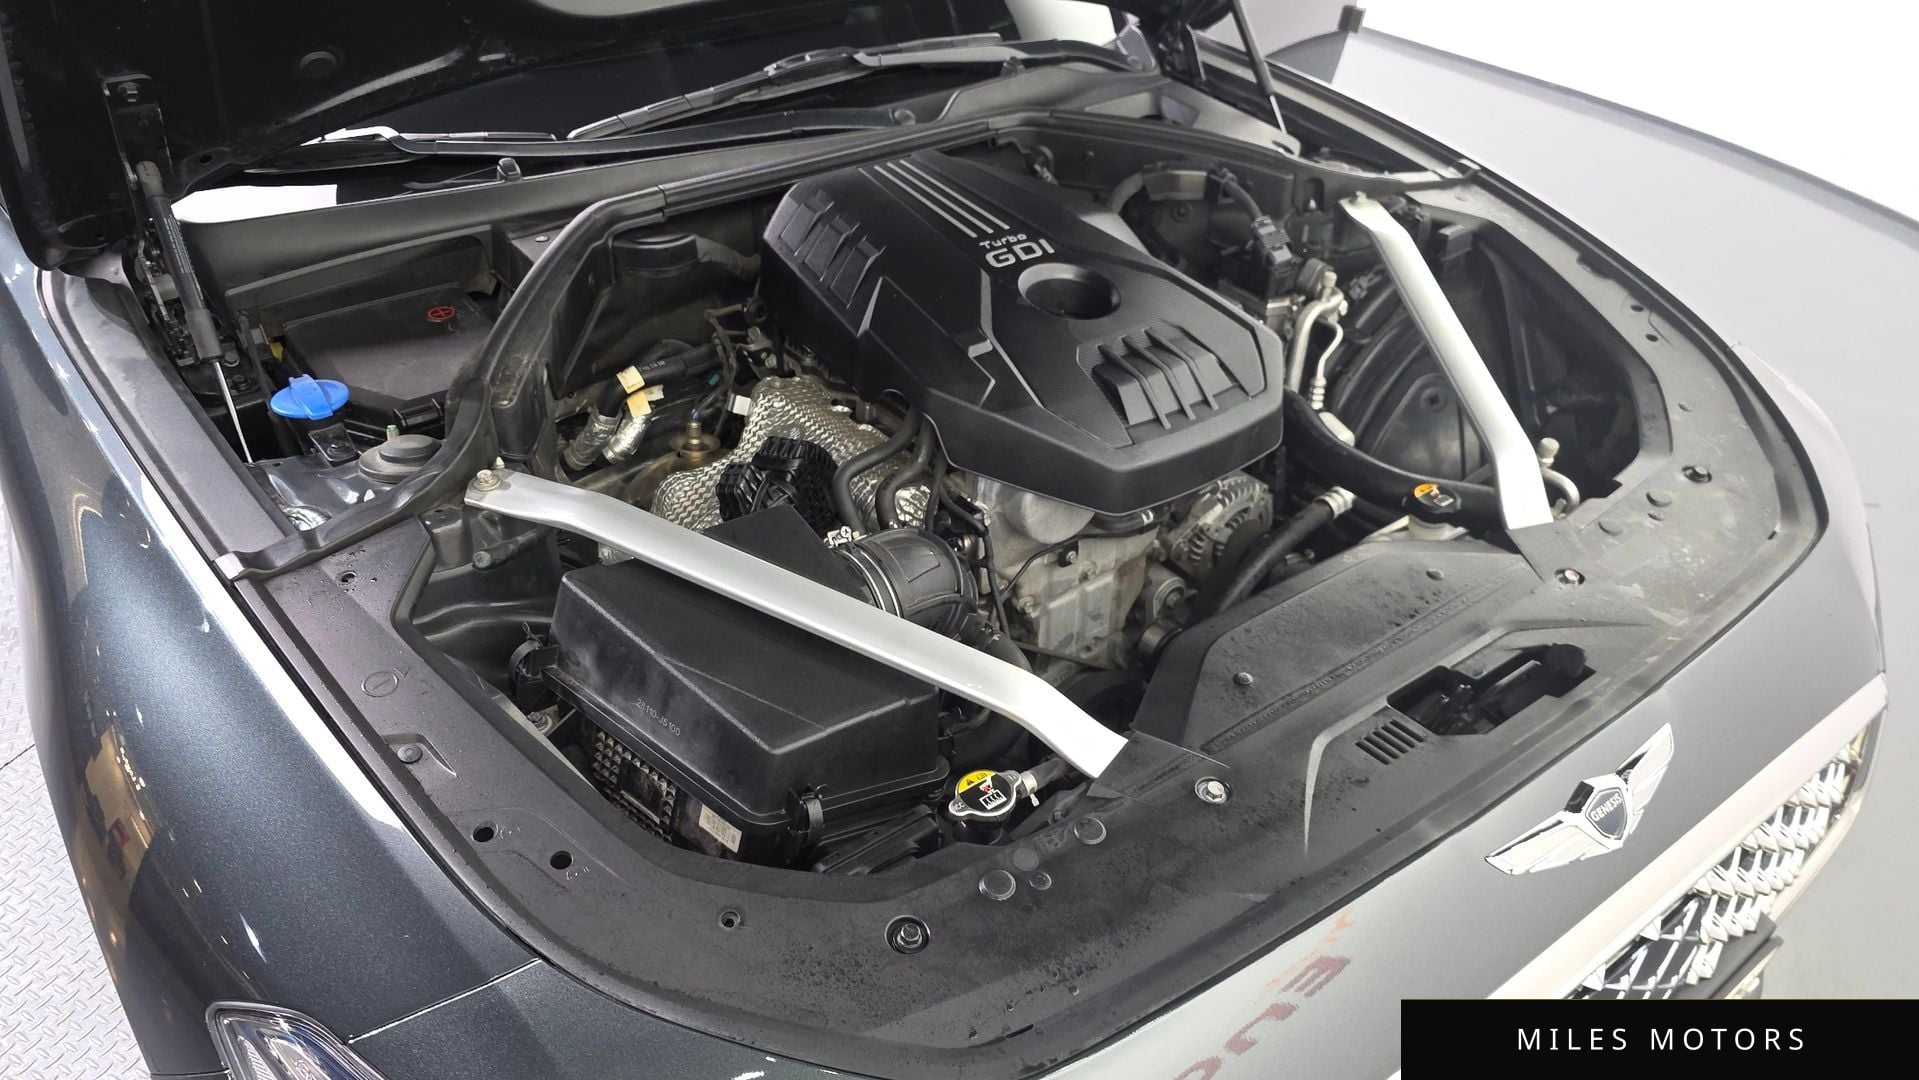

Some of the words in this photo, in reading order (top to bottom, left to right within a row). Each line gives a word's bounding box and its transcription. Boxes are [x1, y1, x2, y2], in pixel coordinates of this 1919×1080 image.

[979, 233, 1027, 249] Turbo
[985, 239, 1055, 268] GDI
[636, 698, 681, 736] 28110-J5100
[1590, 792, 1622, 822] GENESIS
